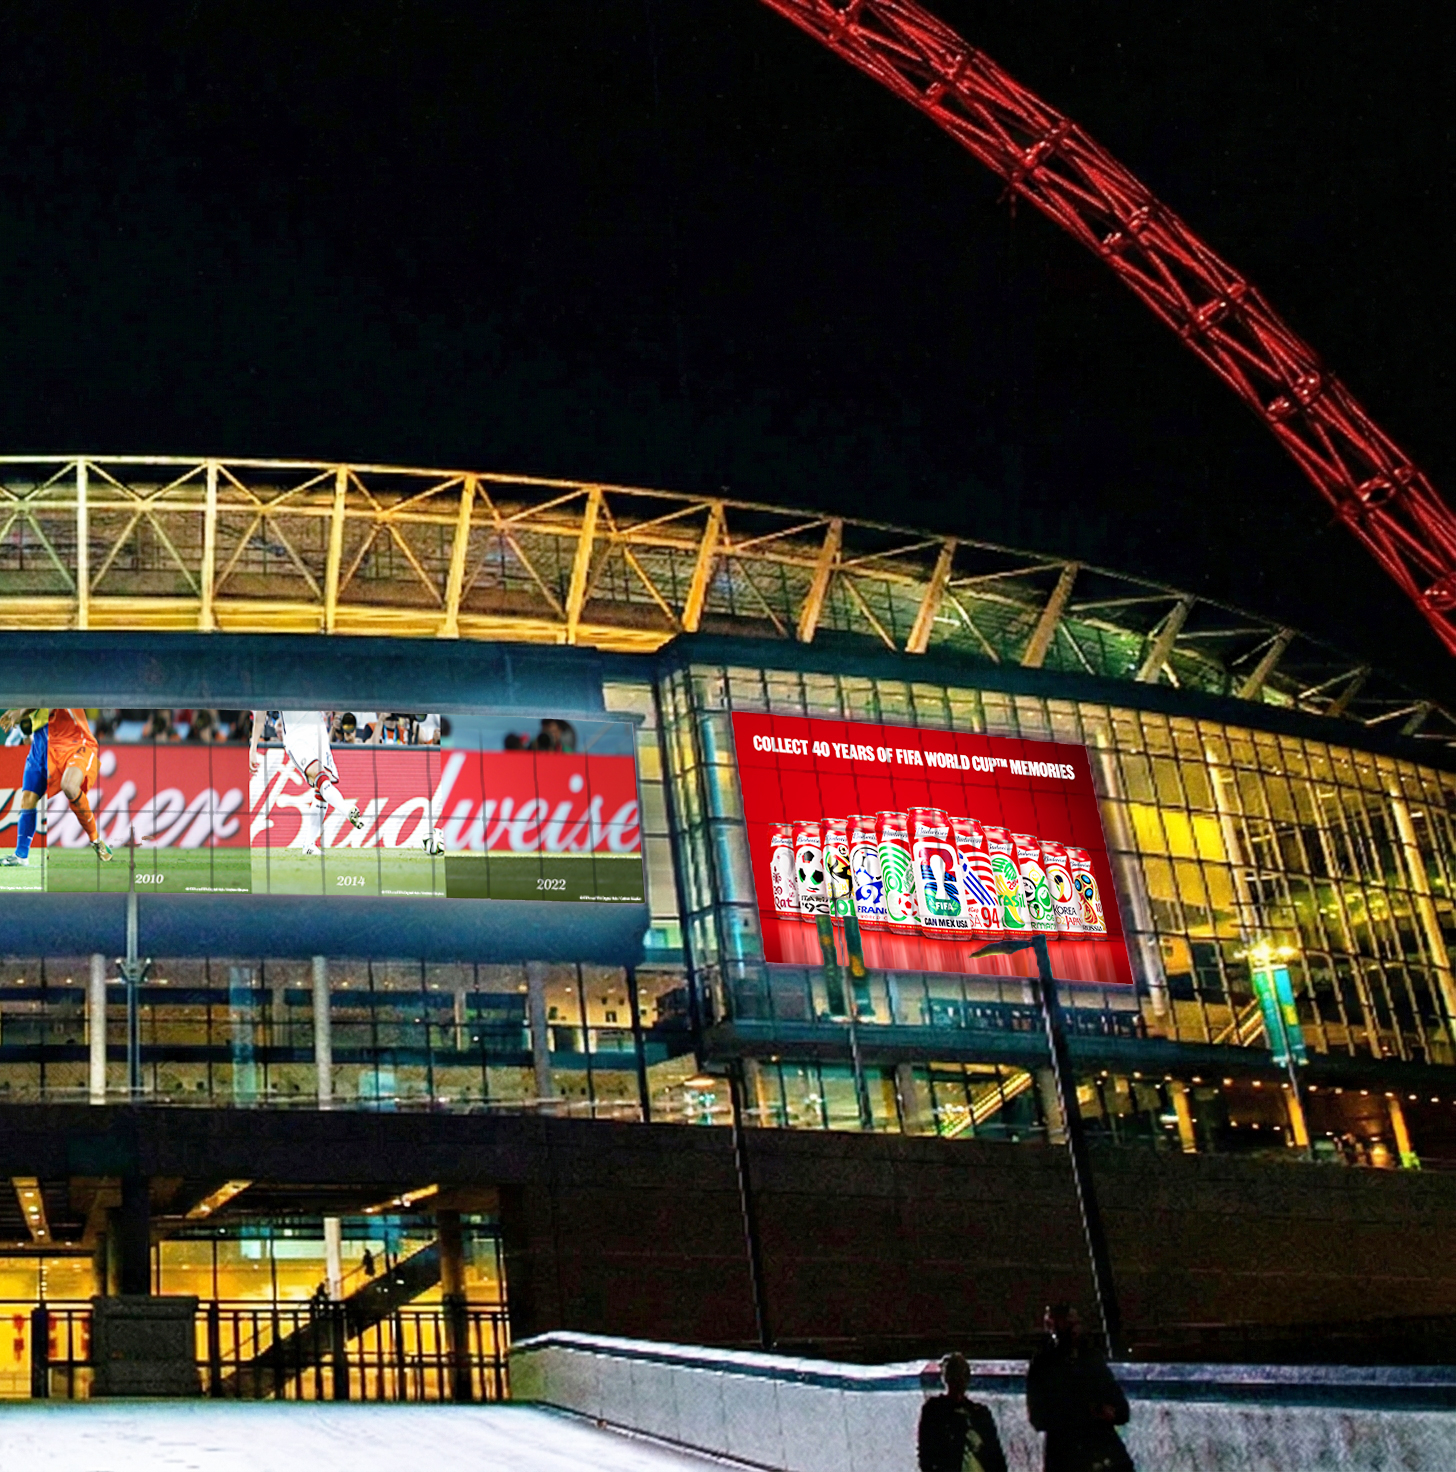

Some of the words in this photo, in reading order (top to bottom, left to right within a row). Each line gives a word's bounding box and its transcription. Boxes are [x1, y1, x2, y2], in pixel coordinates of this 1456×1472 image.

[752, 734, 809, 756] COLLECT
[812, 740, 831, 758] 40
[832, 742, 876, 762] YEARS
[876, 746, 893, 763] OF
[895, 748, 924, 766] FIFA
[924, 750, 971, 771] WORLD
[1009, 758, 1076, 781] MEMORIES
[134, 873, 165, 885] 2010
[335, 875, 367, 887] 2014
[535, 878, 567, 891] 2022
[935, 901, 954, 911] FIFA
[1052, 904, 1078, 917] KOREA
[924, 917, 938, 927] CAN
[938, 918, 956, 928] MEX
[955, 919, 969, 929] USA
[981, 906, 1000, 929] 94
